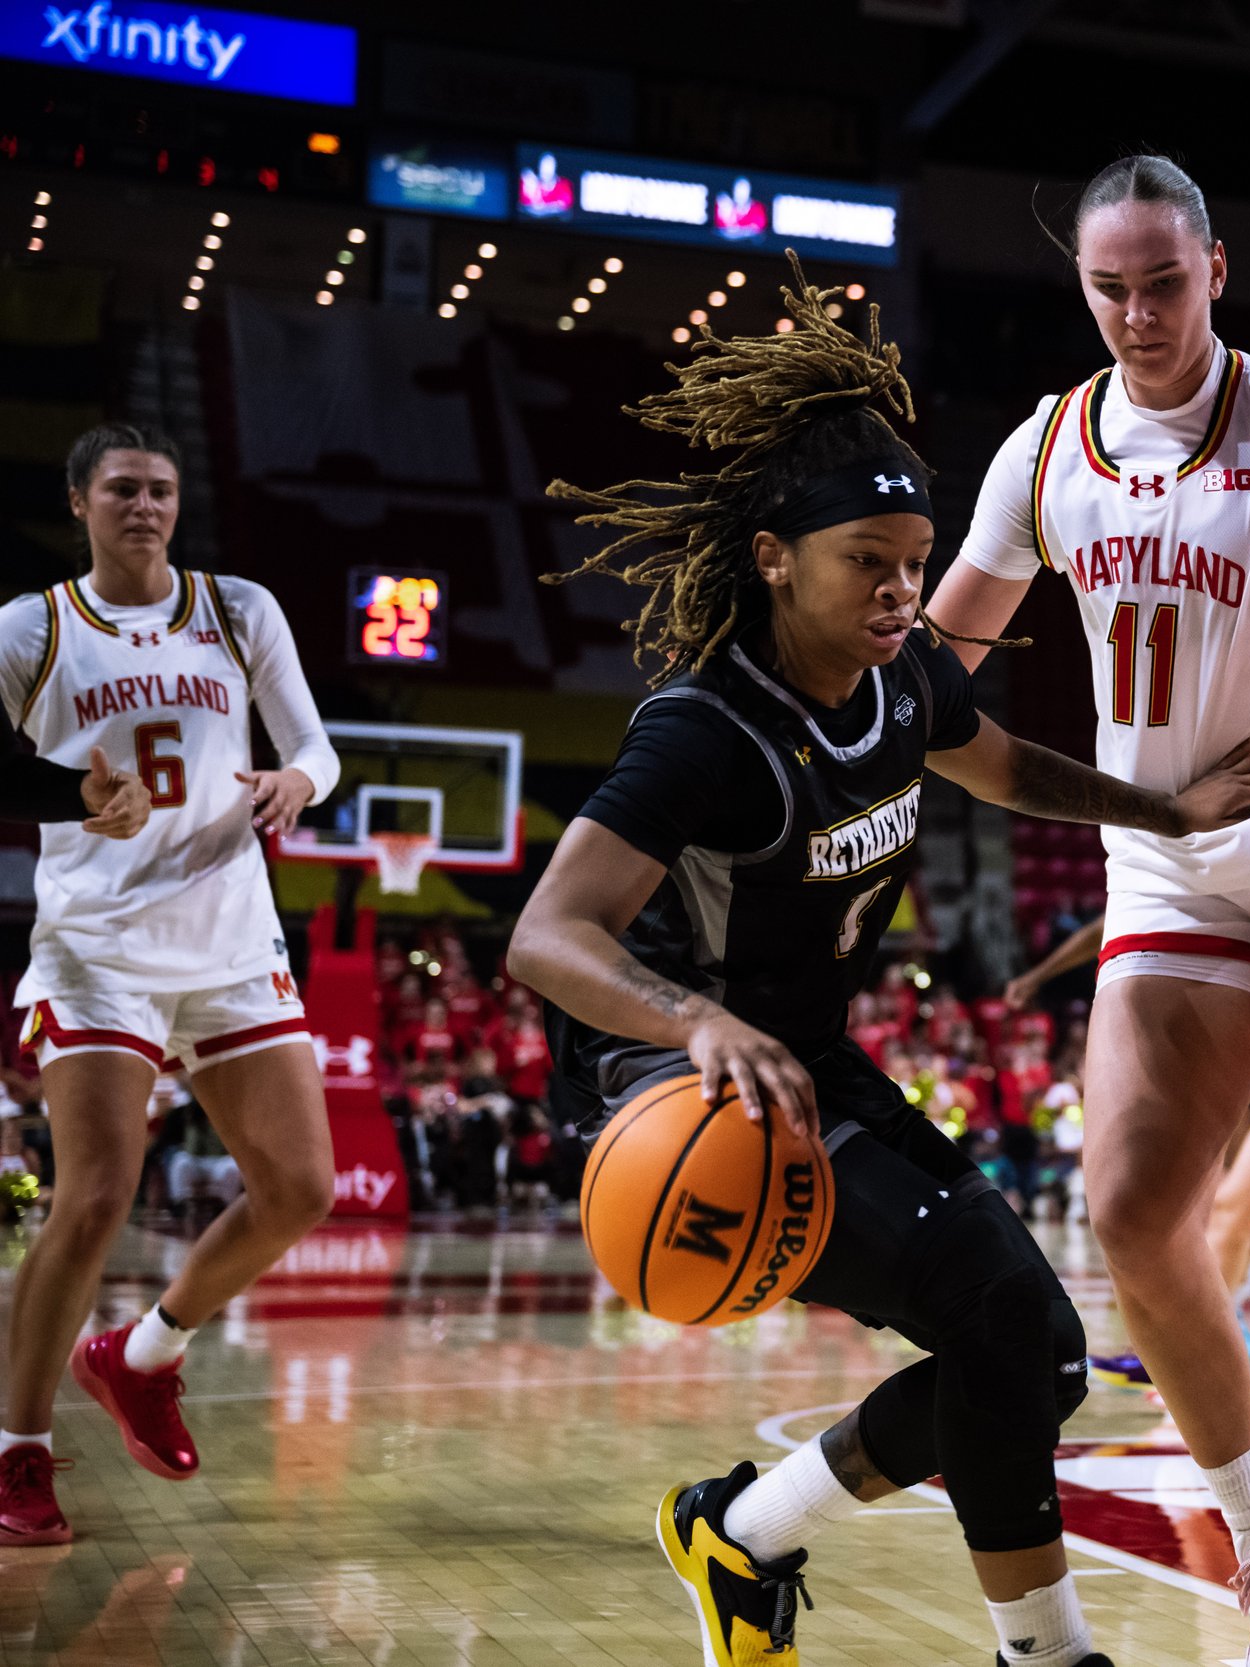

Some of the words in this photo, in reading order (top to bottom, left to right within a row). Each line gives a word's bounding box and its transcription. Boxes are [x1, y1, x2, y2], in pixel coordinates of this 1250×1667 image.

[42, 2, 246, 80] xfinity
[1068, 536, 1246, 609] MARYLAND
[362, 604, 430, 658] 22
[1107, 601, 1179, 728] 11
[73, 674, 229, 730] MARYLAND
[134, 719, 187, 809] 6
[836, 875, 891, 958] 1
[673, 1190, 746, 1268] M
[730, 1161, 815, 1313] wilson
